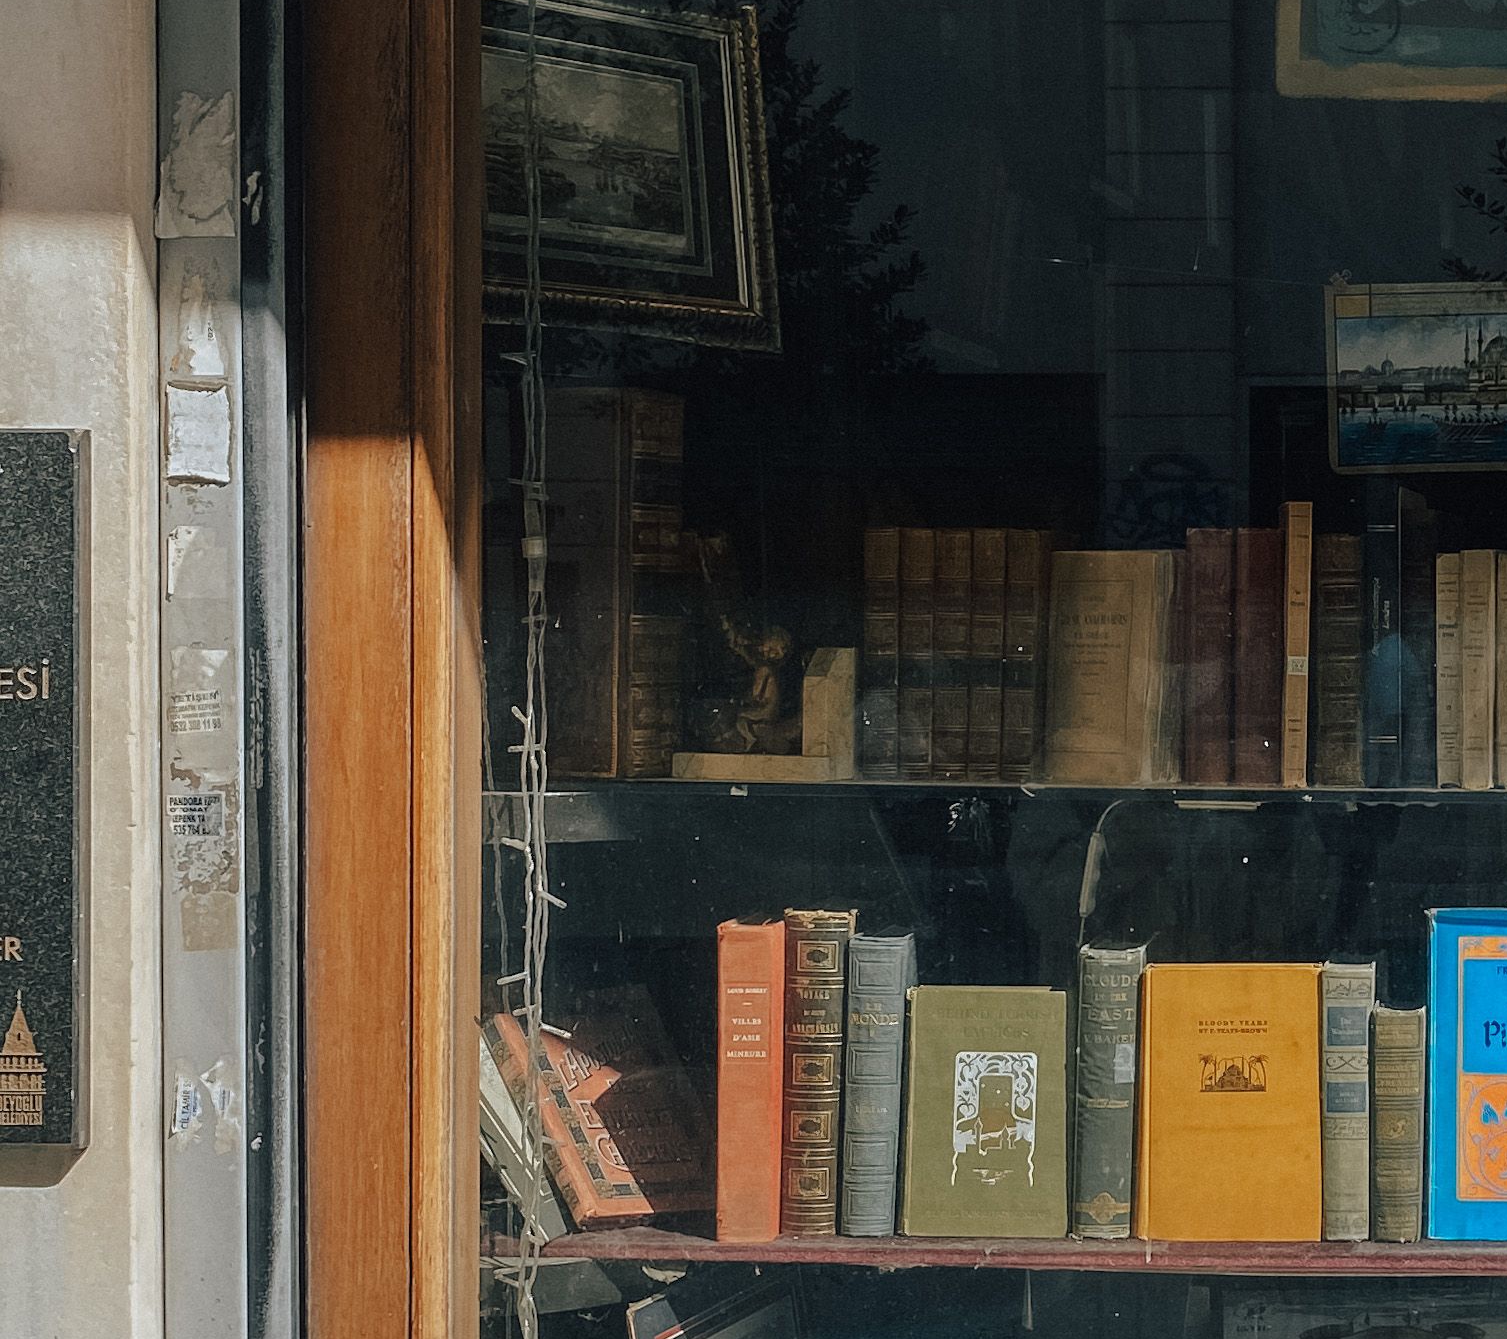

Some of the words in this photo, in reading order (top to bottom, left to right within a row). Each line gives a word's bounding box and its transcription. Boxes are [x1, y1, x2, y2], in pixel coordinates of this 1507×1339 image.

[850, 1013, 900, 1026] MONDE
[1087, 1008, 1135, 1021] EAST
[732, 1034, 761, 1042] D'ASIE
